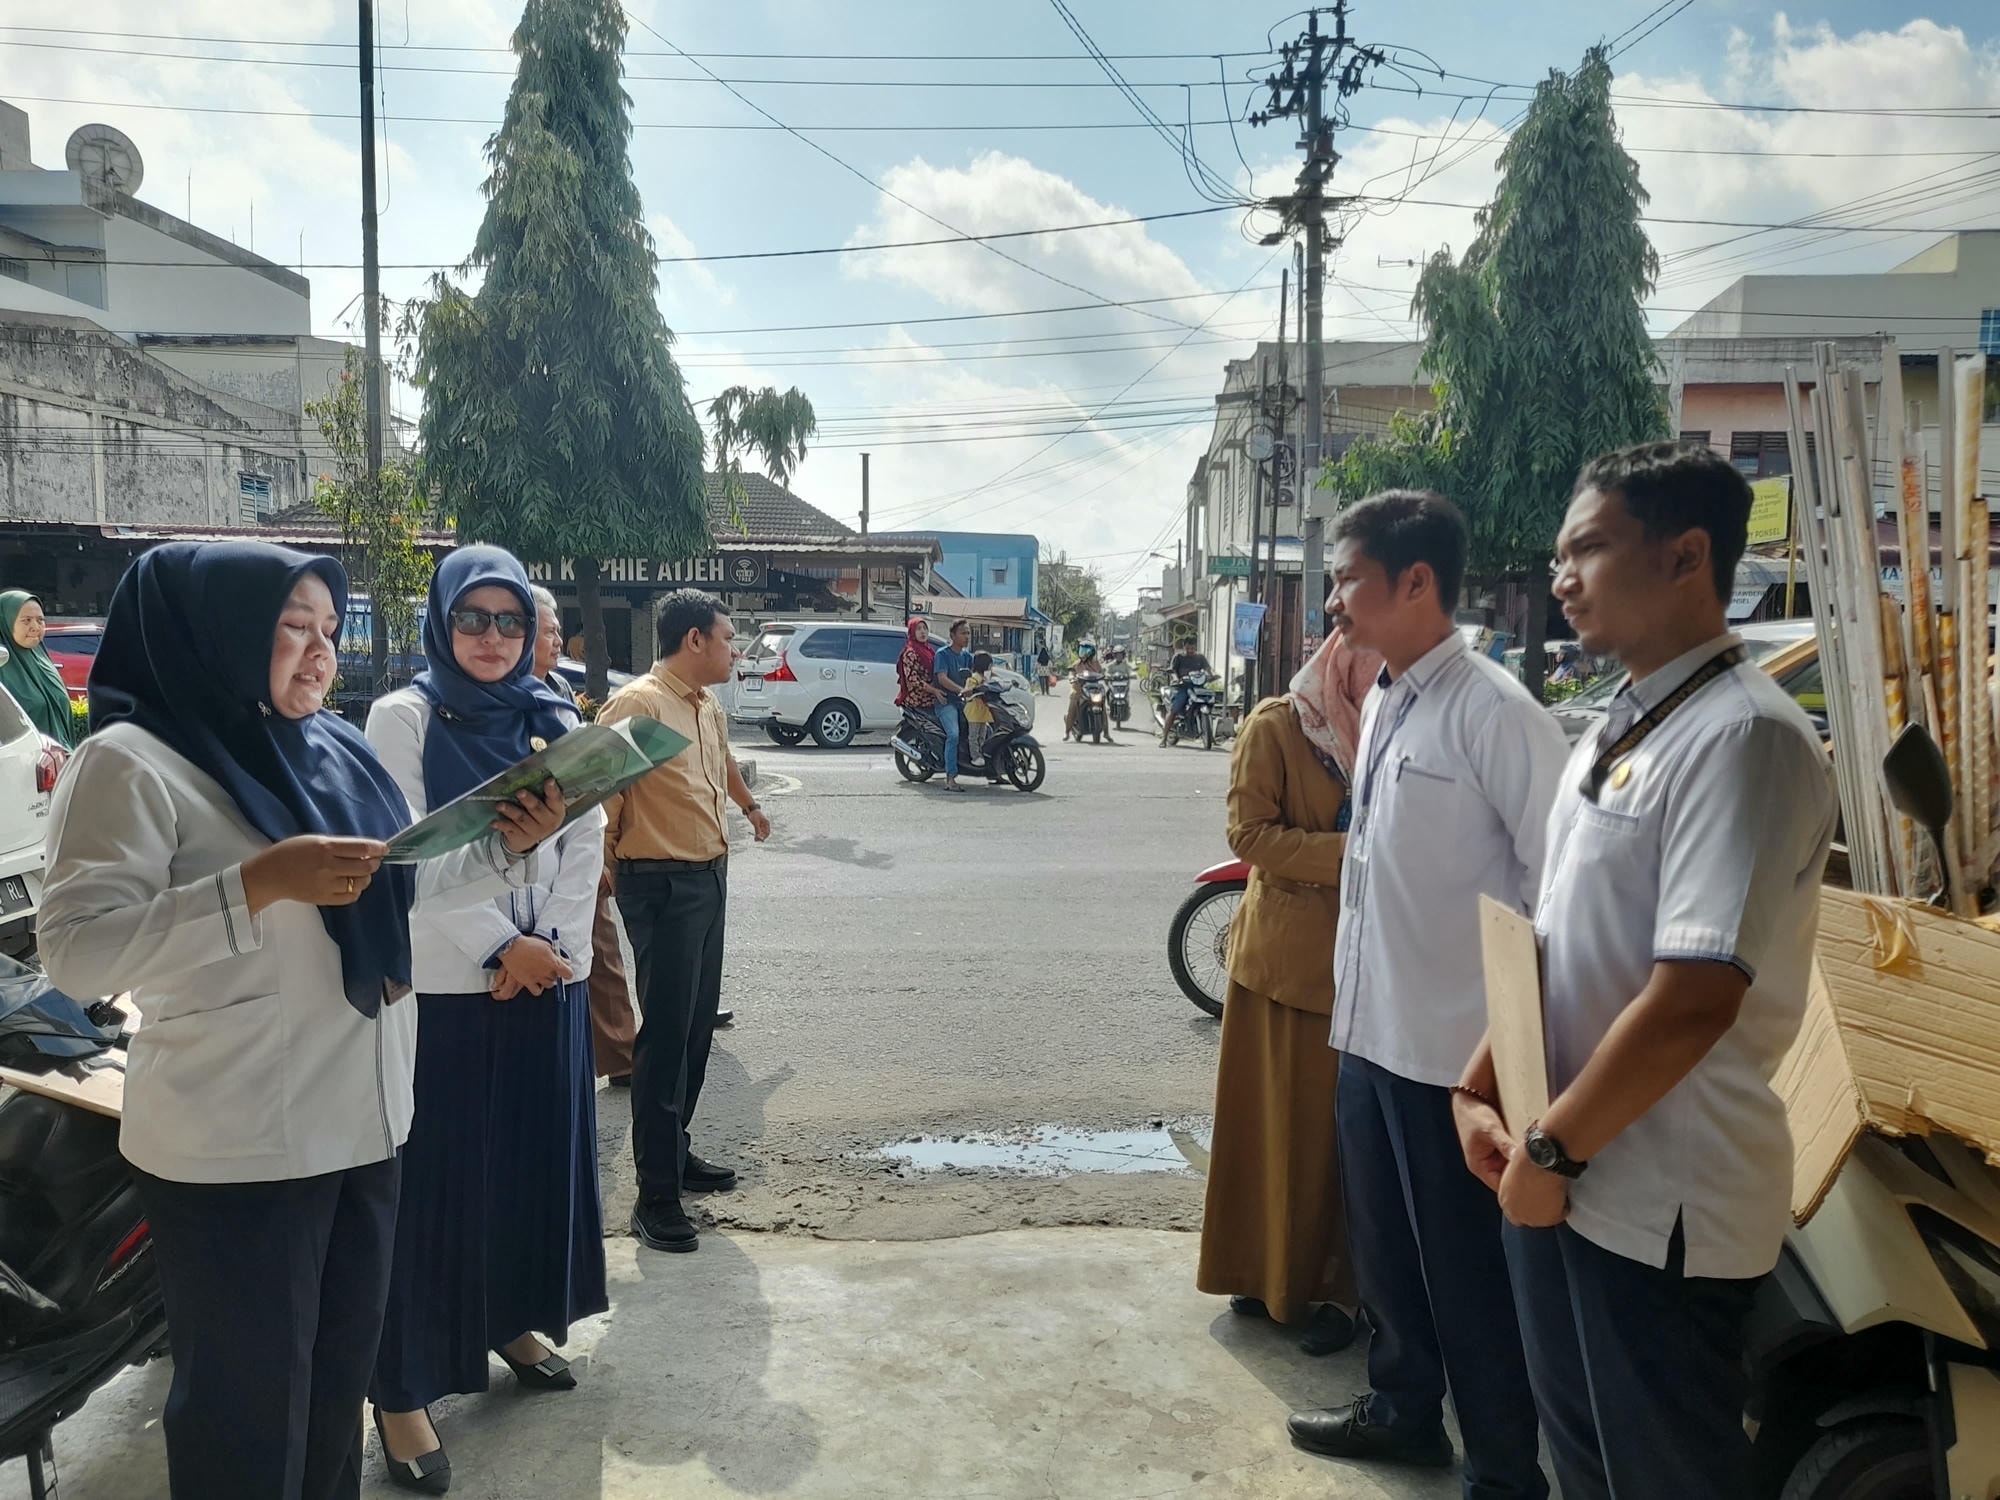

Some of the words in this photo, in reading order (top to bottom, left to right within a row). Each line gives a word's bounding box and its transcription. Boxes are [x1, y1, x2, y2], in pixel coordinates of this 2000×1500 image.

[560, 557, 649, 581] KPHIE
[1231, 557, 1250, 567] JAT
[5, 880, 25, 901] RL
